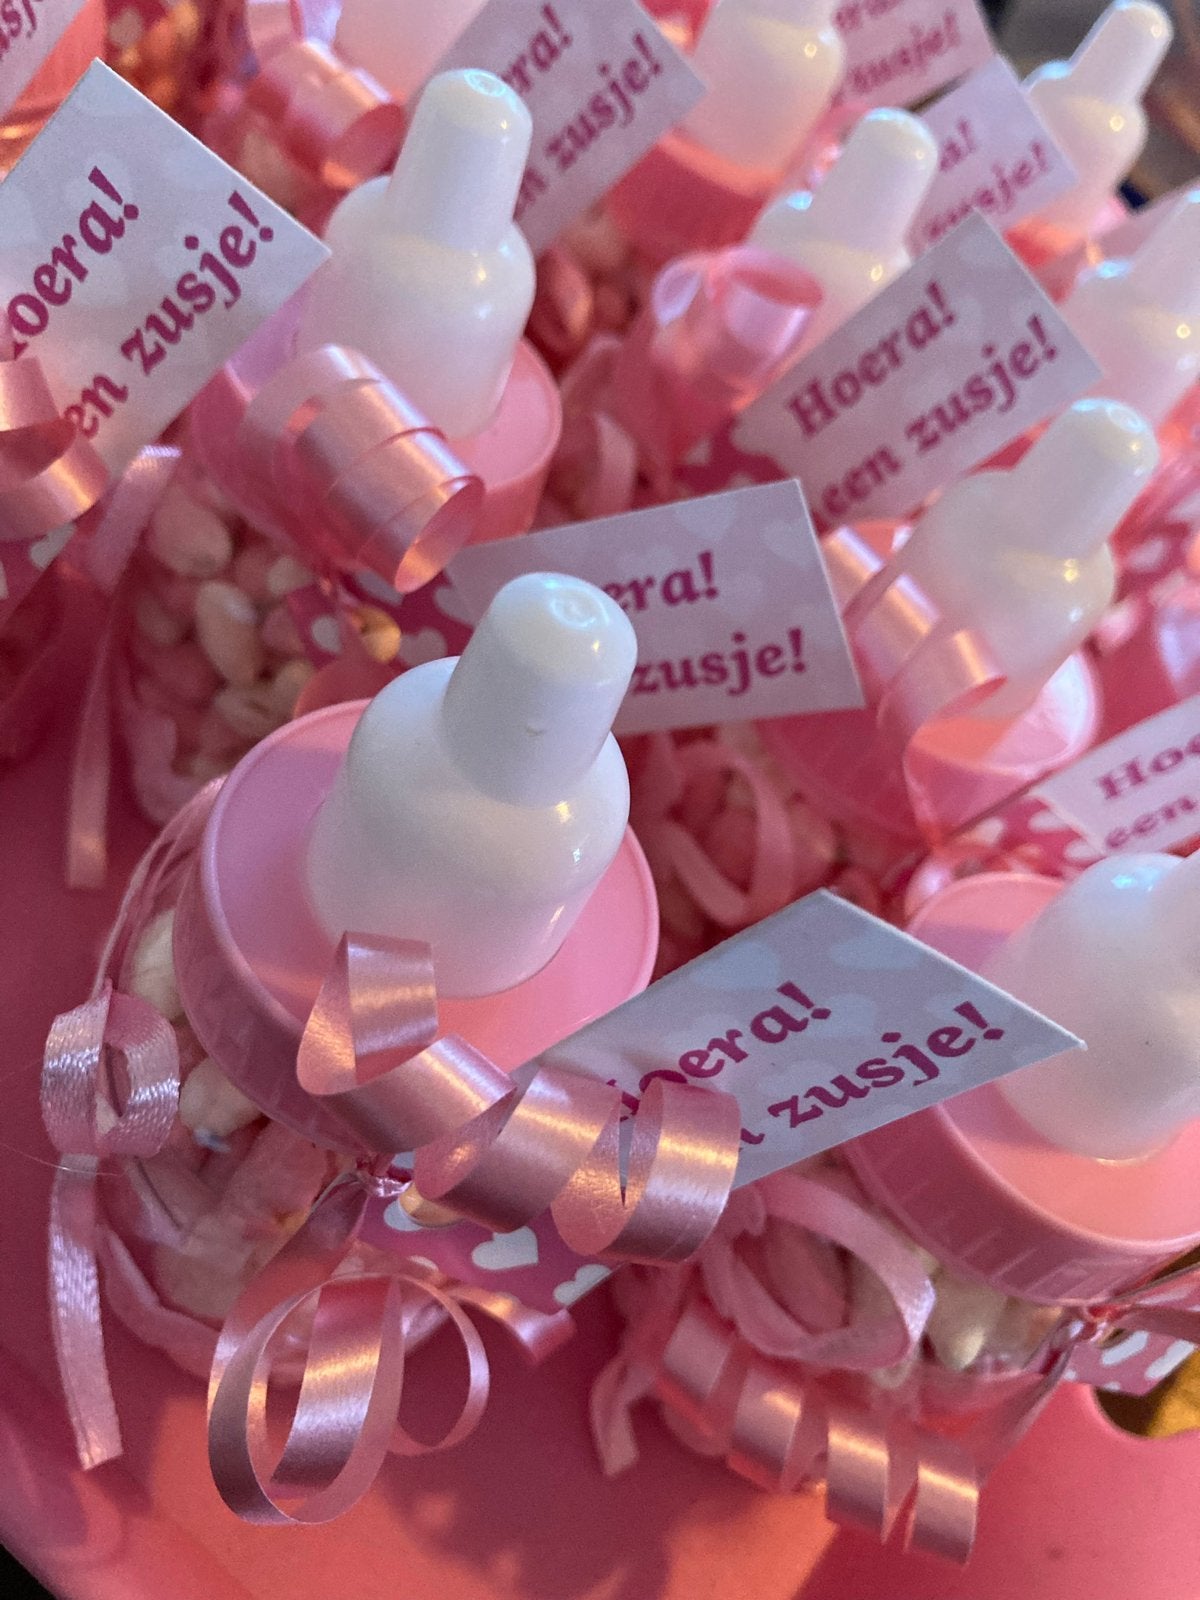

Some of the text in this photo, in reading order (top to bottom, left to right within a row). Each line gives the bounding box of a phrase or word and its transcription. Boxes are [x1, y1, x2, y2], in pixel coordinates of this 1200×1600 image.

[545, 27, 663, 173] zusje!
[7, 166, 139, 360] oera!
[63, 189, 274, 438] en zusje!
[787, 280, 957, 438] Hoera!
[821, 313, 1057, 518] een zusje!
[631, 627, 806, 696] zusje!
[767, 1000, 1005, 1128] zusje!
